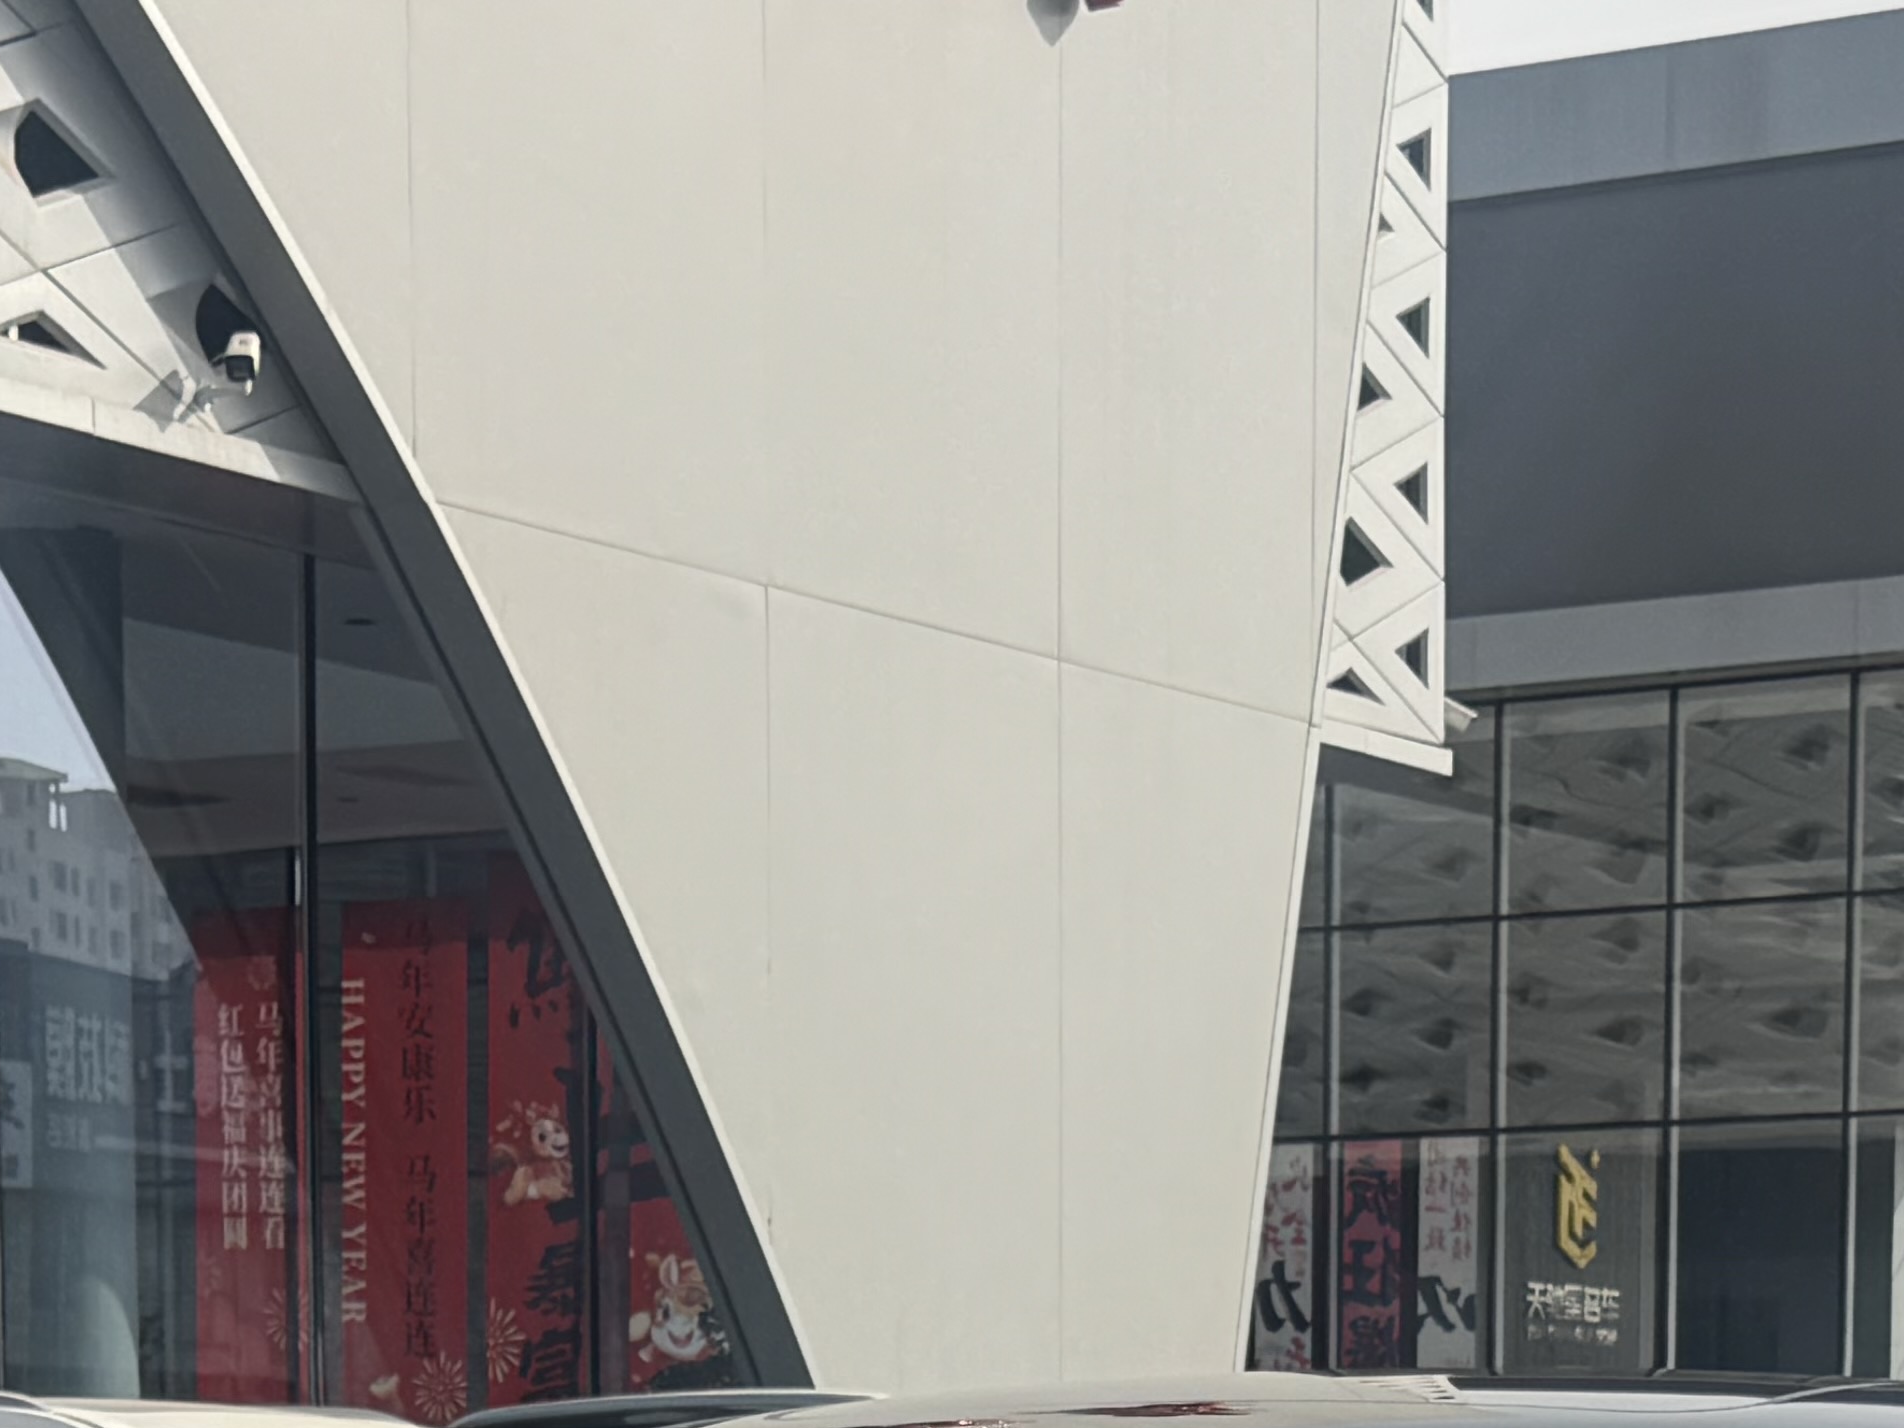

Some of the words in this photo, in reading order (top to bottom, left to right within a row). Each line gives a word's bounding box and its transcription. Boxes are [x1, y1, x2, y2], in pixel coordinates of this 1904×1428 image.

[341, 978, 367, 1107] HAPPY
[341, 1121, 367, 1216] NEW
[341, 1224, 367, 1323] YEAR
